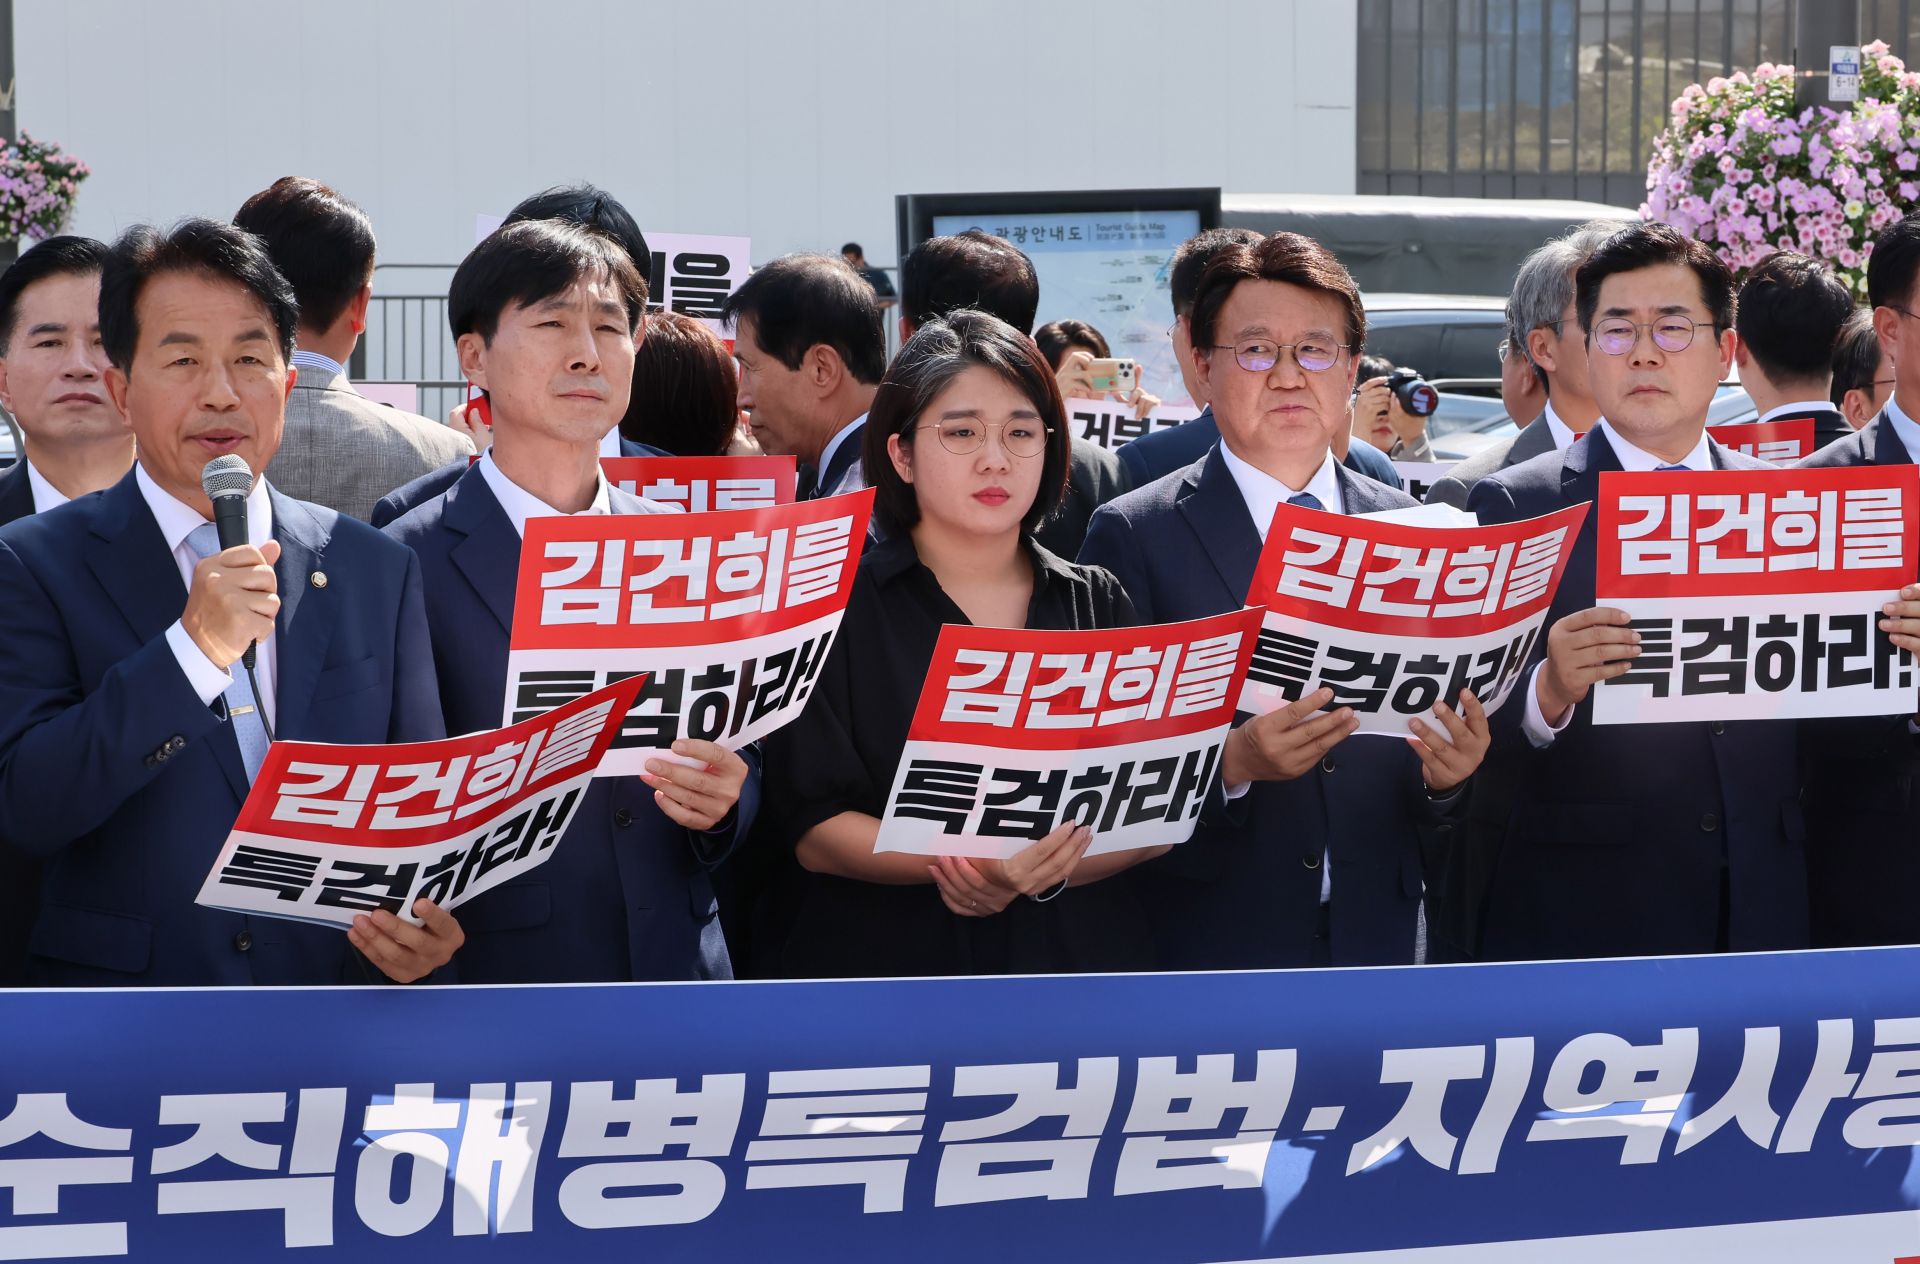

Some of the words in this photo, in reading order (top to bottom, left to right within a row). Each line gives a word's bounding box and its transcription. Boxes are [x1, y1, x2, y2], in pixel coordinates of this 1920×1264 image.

[1096, 223, 1122, 232] Tourist
[1149, 223, 1166, 232] Map
[1073, 411, 1195, 448] 거부
[540, 515, 854, 626] 김건희를
[1276, 526, 1569, 618] 김건희를
[1617, 487, 1904, 575] 김건희를
[939, 631, 1243, 729] 김건희를
[271, 698, 617, 830] 김건희를
[893, 744, 1221, 841] 특검하라!
[219, 787, 582, 918] 특검하라!
